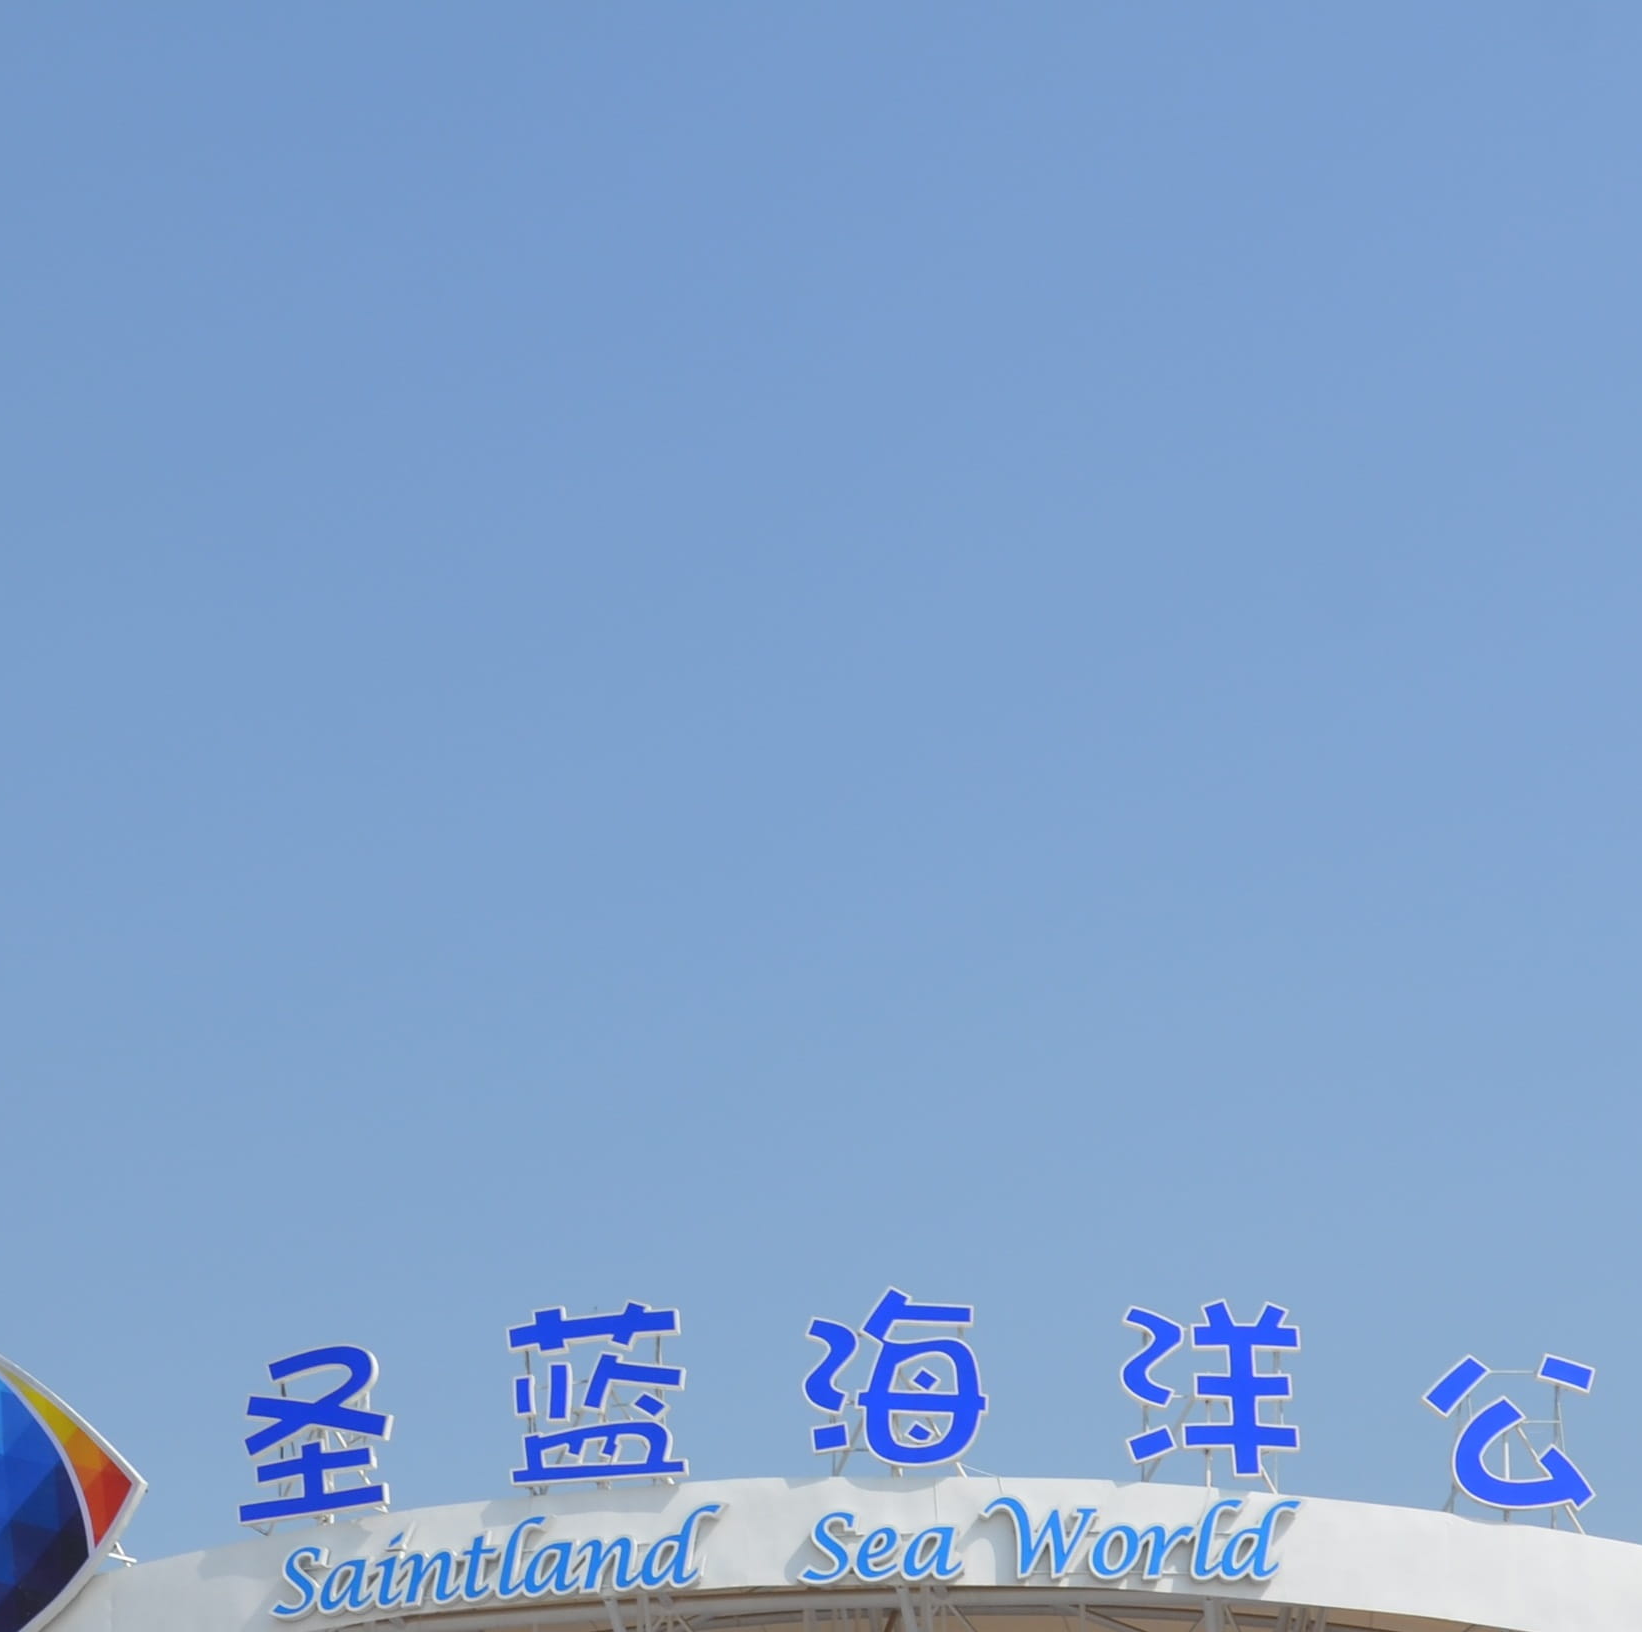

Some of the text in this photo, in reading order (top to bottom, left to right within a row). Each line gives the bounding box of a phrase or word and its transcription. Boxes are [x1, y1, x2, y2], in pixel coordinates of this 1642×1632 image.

[270, 1496, 1301, 1619] Saintland Sea World
